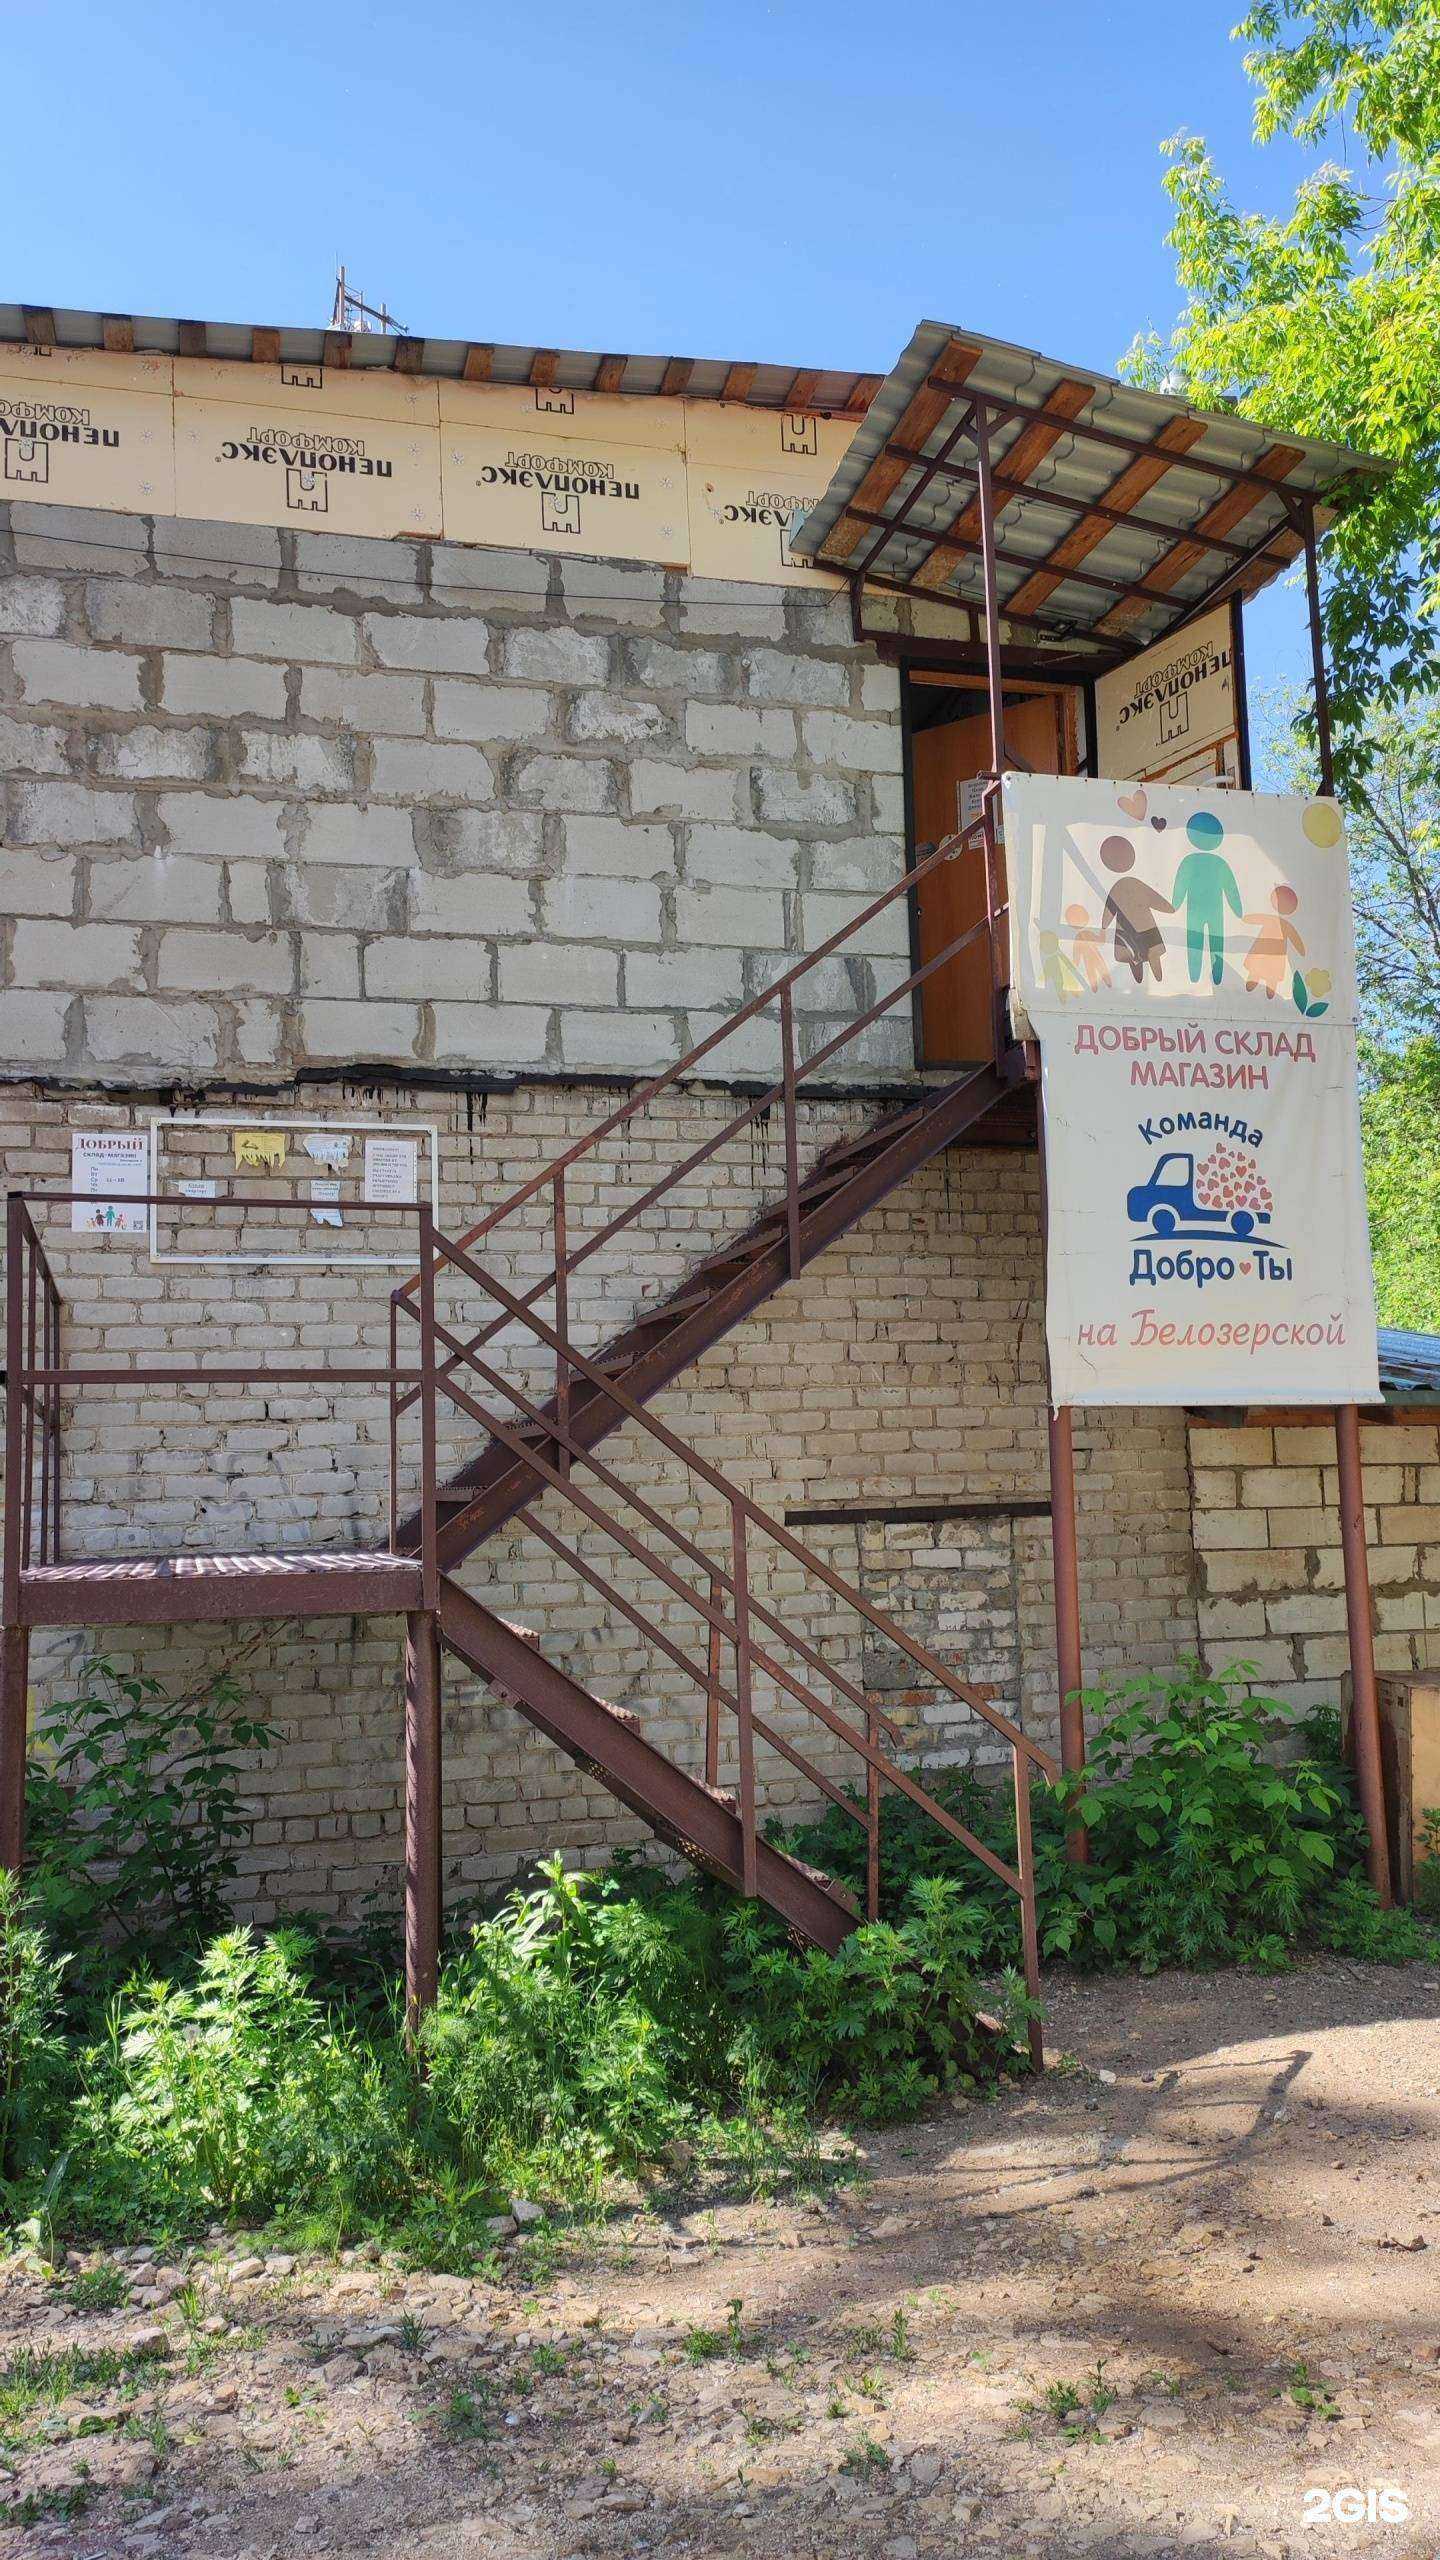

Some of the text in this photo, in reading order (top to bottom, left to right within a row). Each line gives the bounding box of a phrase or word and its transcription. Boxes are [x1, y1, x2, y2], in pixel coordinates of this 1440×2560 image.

[247, 427, 365, 457] КОМФОРТ
[505, 451, 614, 479] КОМФОРТ
[1134, 641, 1214, 699] КОМФОРТ
[1074, 1022, 1316, 1063] ДОБРЫЙ СКЛАД
[1131, 1060, 1268, 1090] МАГАЗИН
[1138, 1111, 1264, 1148] Команда
[1129, 1249, 1293, 1288] Добро Ты
[1078, 1308, 1346, 1355] на Белозерской
